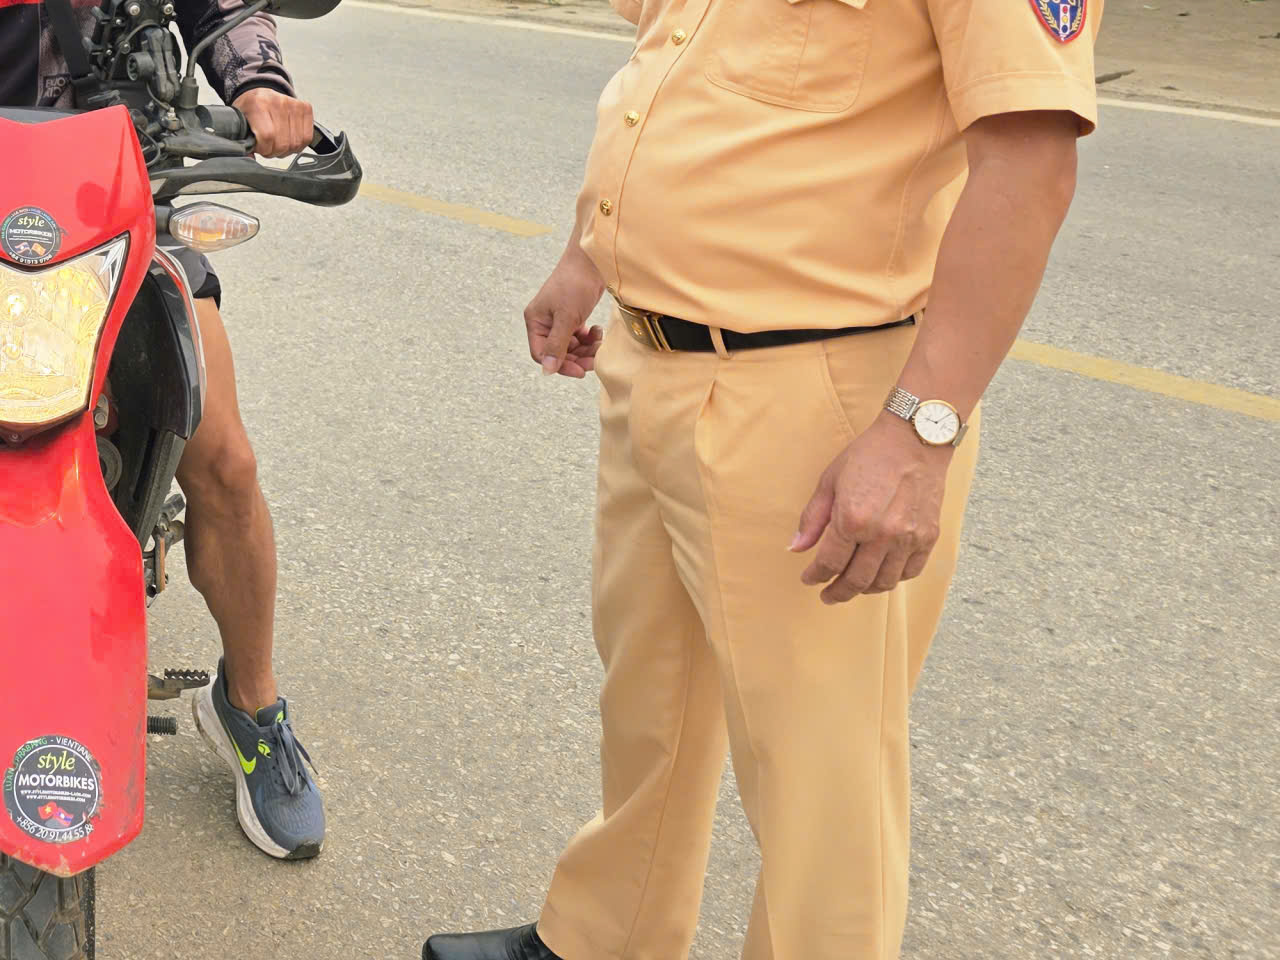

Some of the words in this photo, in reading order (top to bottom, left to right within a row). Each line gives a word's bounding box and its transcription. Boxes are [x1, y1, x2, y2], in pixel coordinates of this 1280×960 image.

[17, 216, 45, 228] style
[37, 750, 76, 775] style
[18, 774, 95, 791] MOTORBIKES
[16, 815, 36, 834] +856
[35, 827, 48, 839] 20
[74, 826, 85, 838] 55
